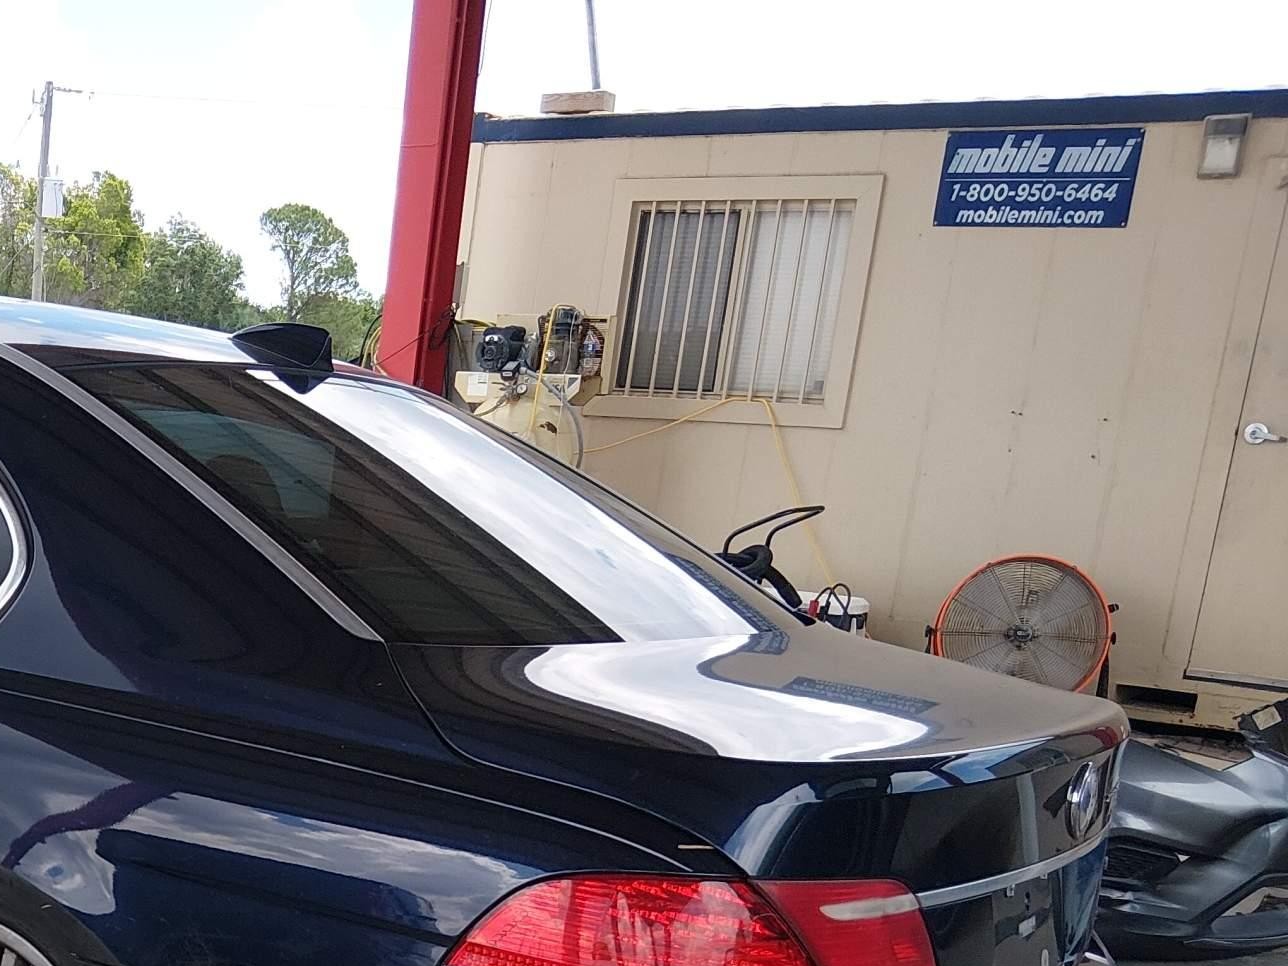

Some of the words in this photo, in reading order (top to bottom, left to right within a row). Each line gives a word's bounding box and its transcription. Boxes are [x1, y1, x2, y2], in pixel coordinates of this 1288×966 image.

[947, 134, 1055, 174] mobile
[1054, 138, 1136, 173] mini
[950, 183, 1119, 202] 1-800-950-6464
[956, 206, 1105, 224] mobilemini.com
